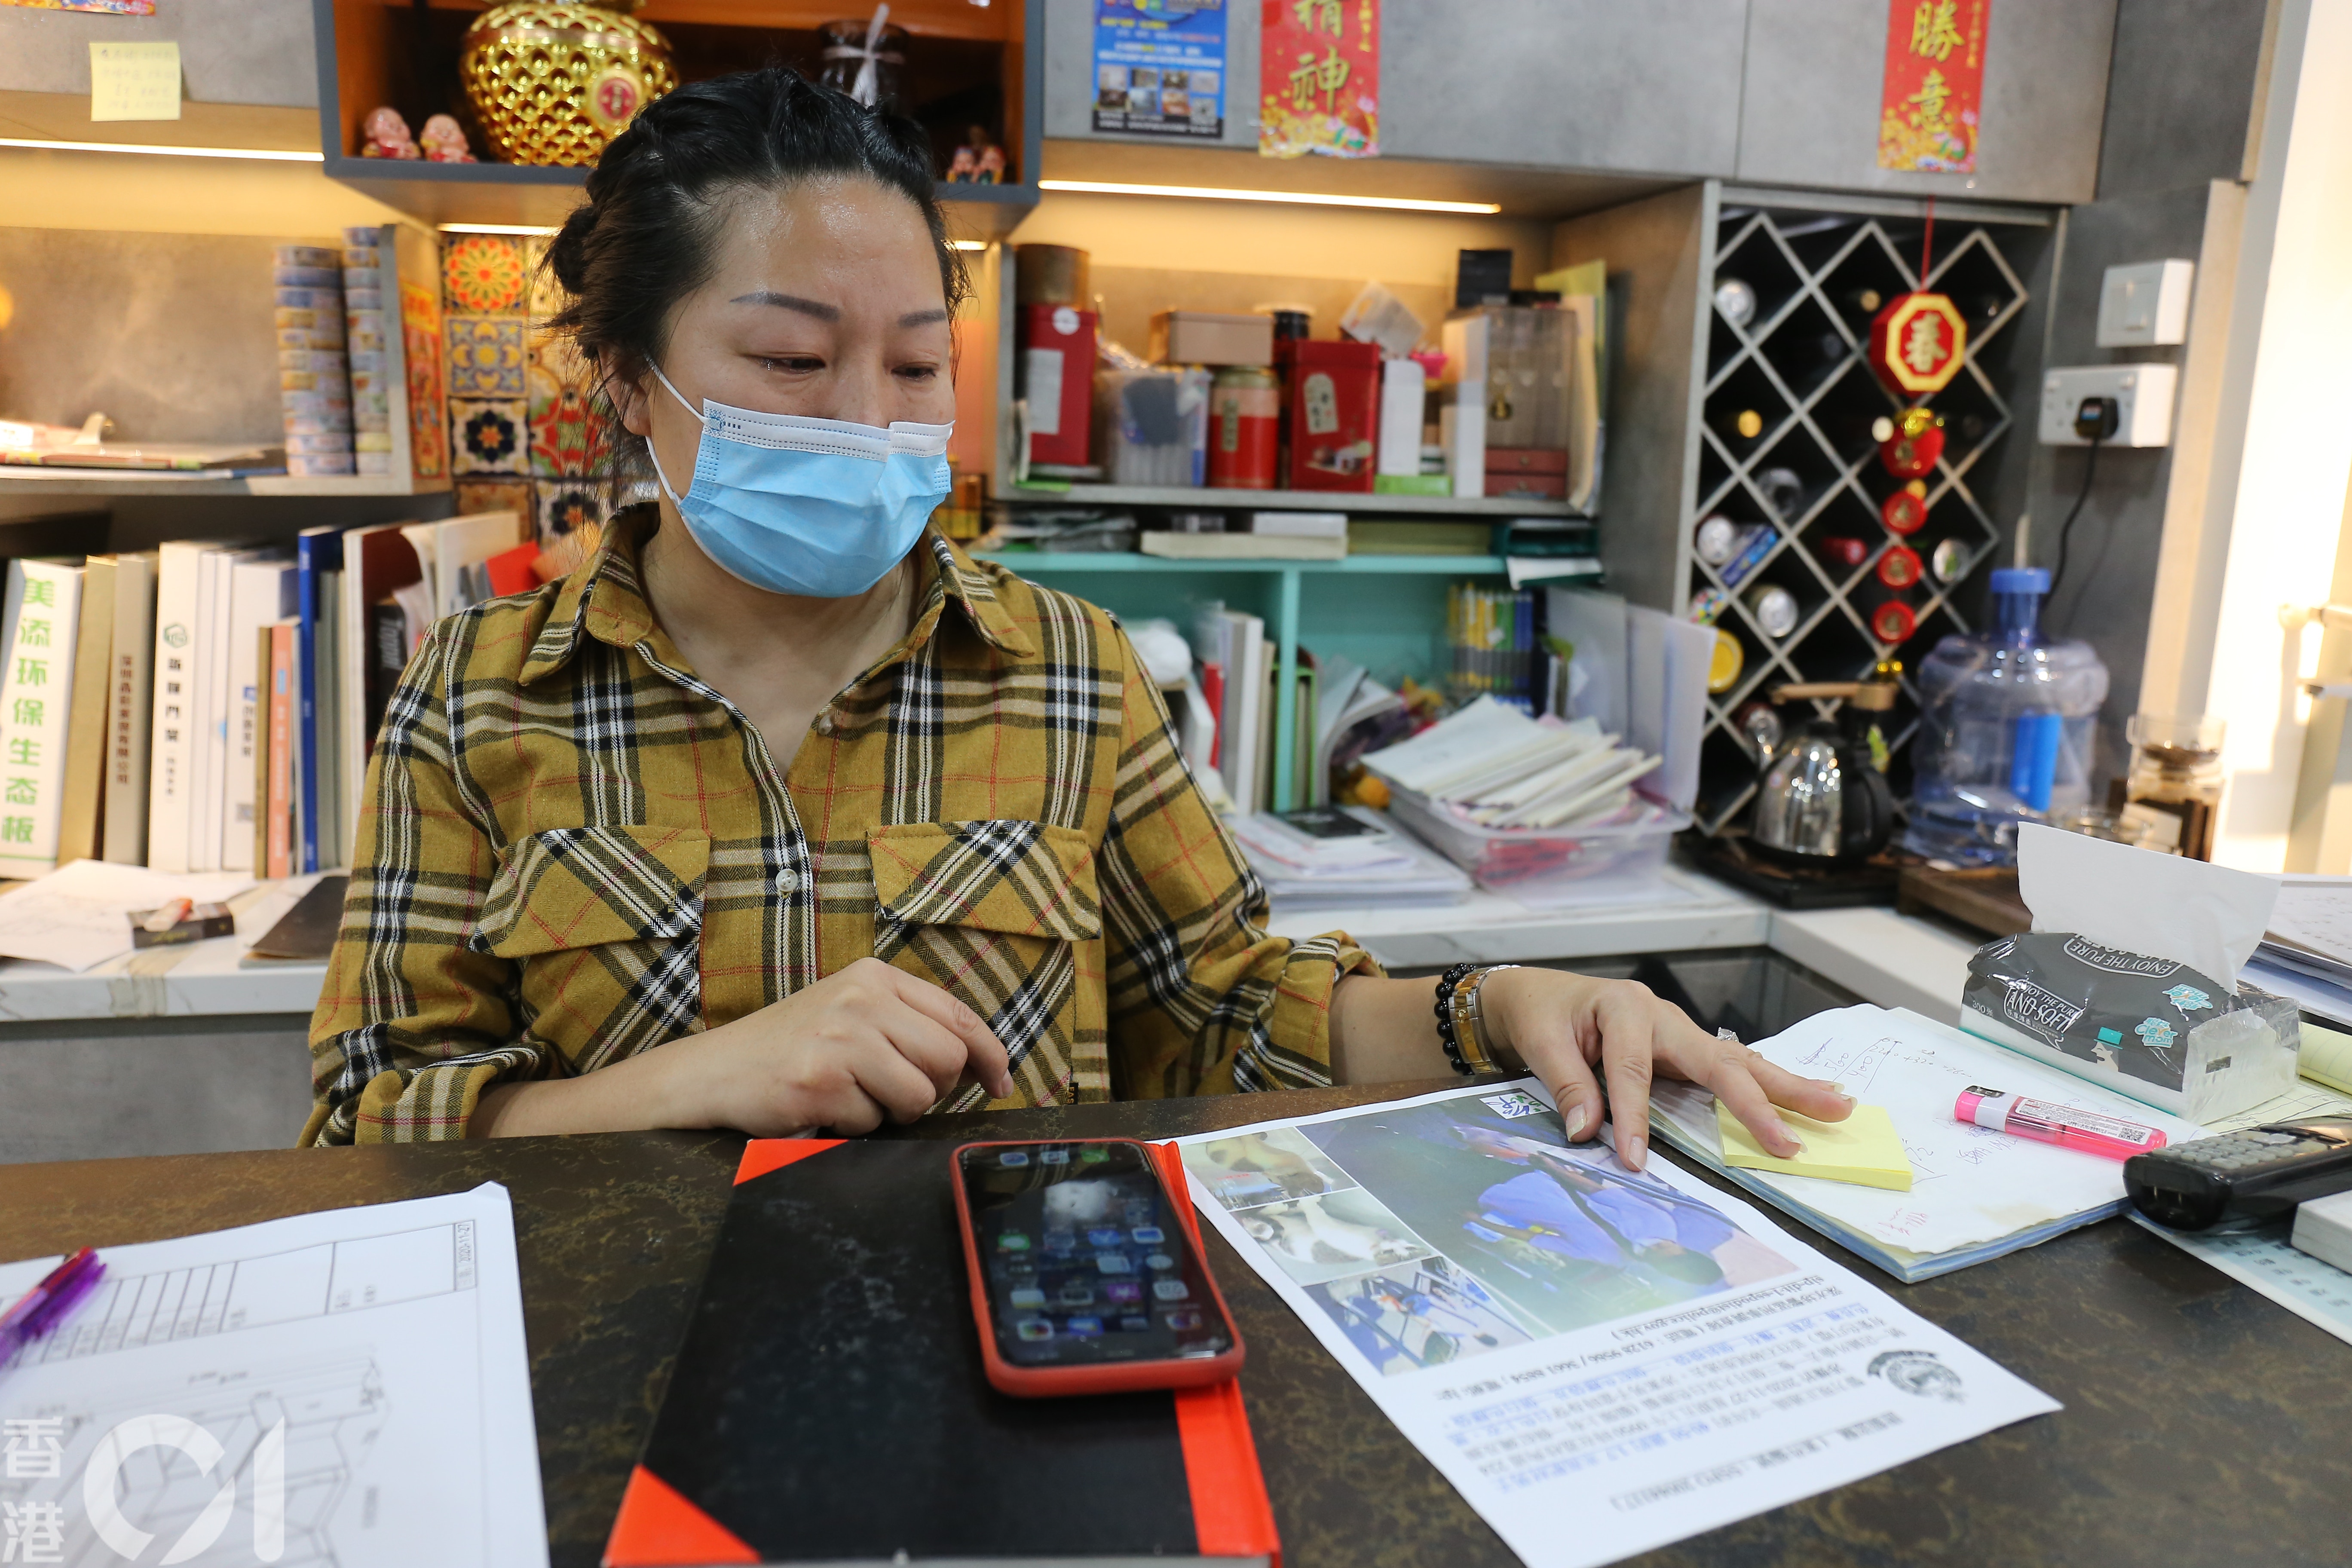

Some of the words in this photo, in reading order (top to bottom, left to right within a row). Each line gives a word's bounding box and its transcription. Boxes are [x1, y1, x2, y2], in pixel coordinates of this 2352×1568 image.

[1905, 312, 1947, 373] 春
[1, 577, 56, 844] 美添环保生态板
[2070, 941, 2106, 963] PURE
[2103, 955, 2130, 969] THE
[2128, 961, 2171, 974] ENJOY
[2007, 989, 2037, 1016] AND
[2017, 981, 2042, 998] JOY
[2041, 994, 2058, 1007] THE
[2056, 1003, 2080, 1020] PUR
[2137, 1024, 2177, 1037] Clever
[2144, 1035, 2173, 1043] mom
[457, 1223, 470, 1263] 2020-11-27
[1588, 1350, 1621, 1363] 9586
[1621, 1341, 1656, 1354] 6128
